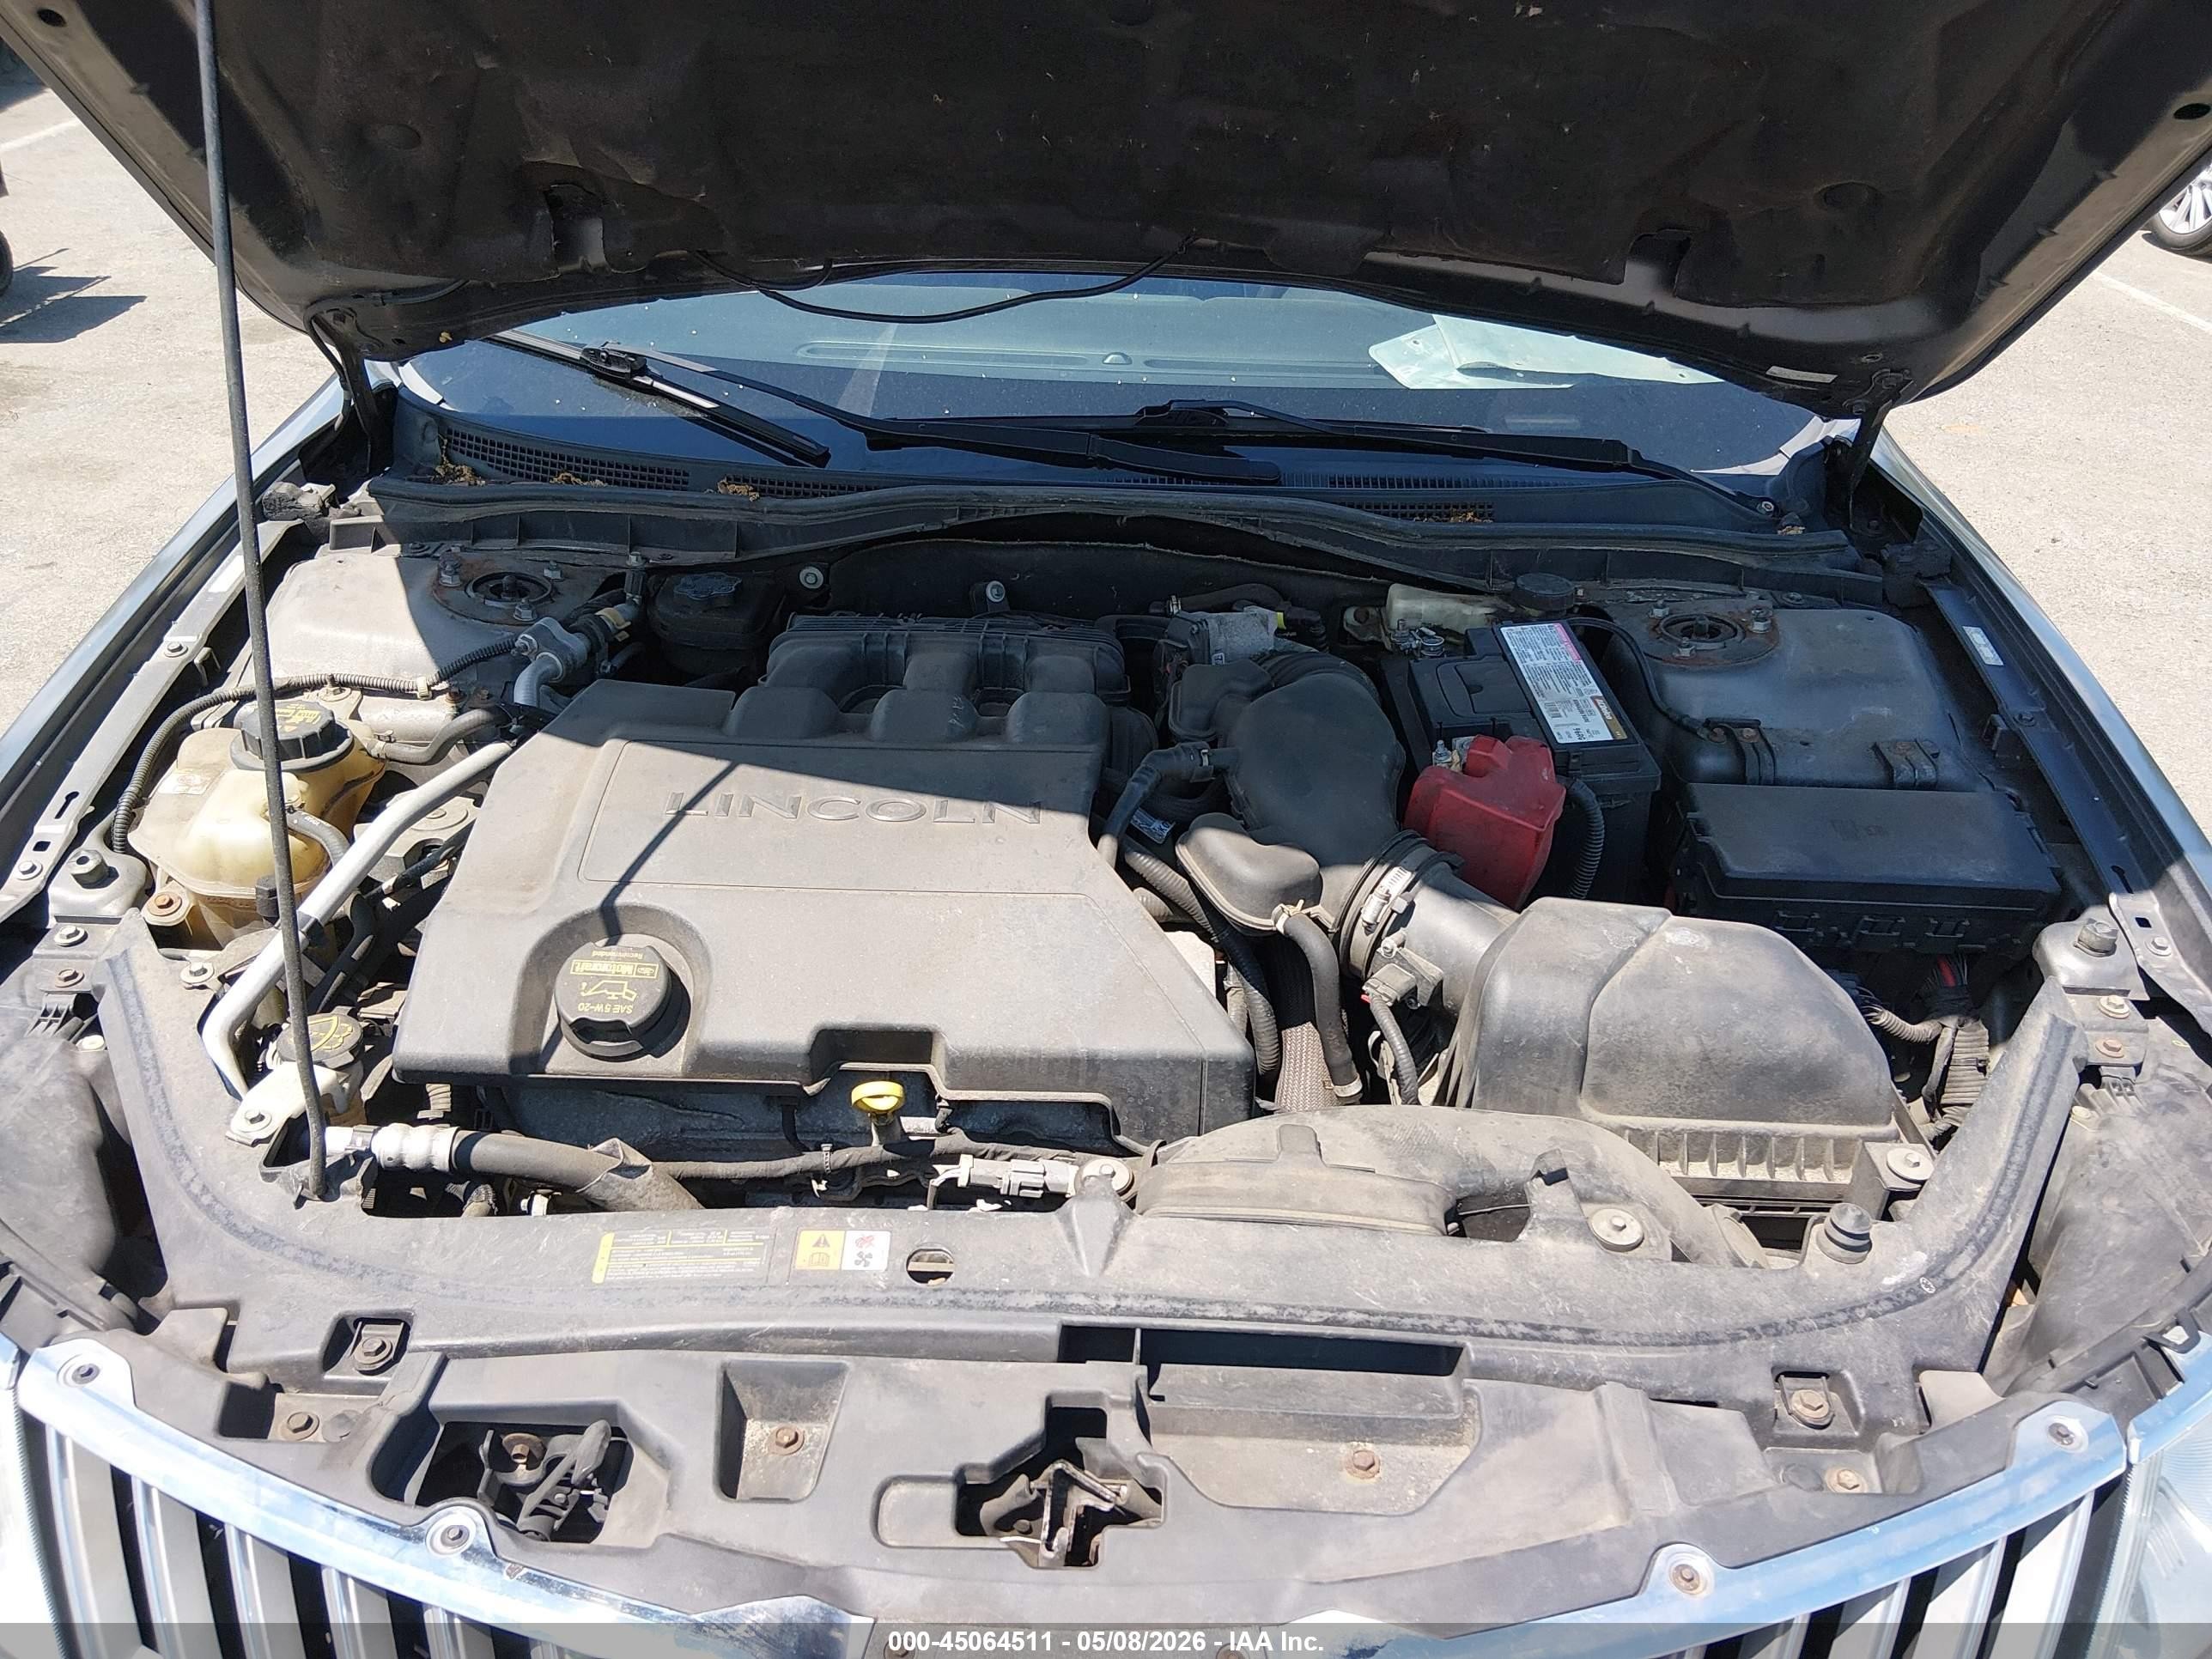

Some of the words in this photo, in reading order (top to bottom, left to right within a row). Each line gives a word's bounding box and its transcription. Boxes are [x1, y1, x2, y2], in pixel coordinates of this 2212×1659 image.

[665, 792, 1044, 824] LINCOLN
[574, 962, 635, 975] Motorcraft
[578, 1003, 611, 1013] 5W-20
[610, 1004, 634, 1014] SAE
